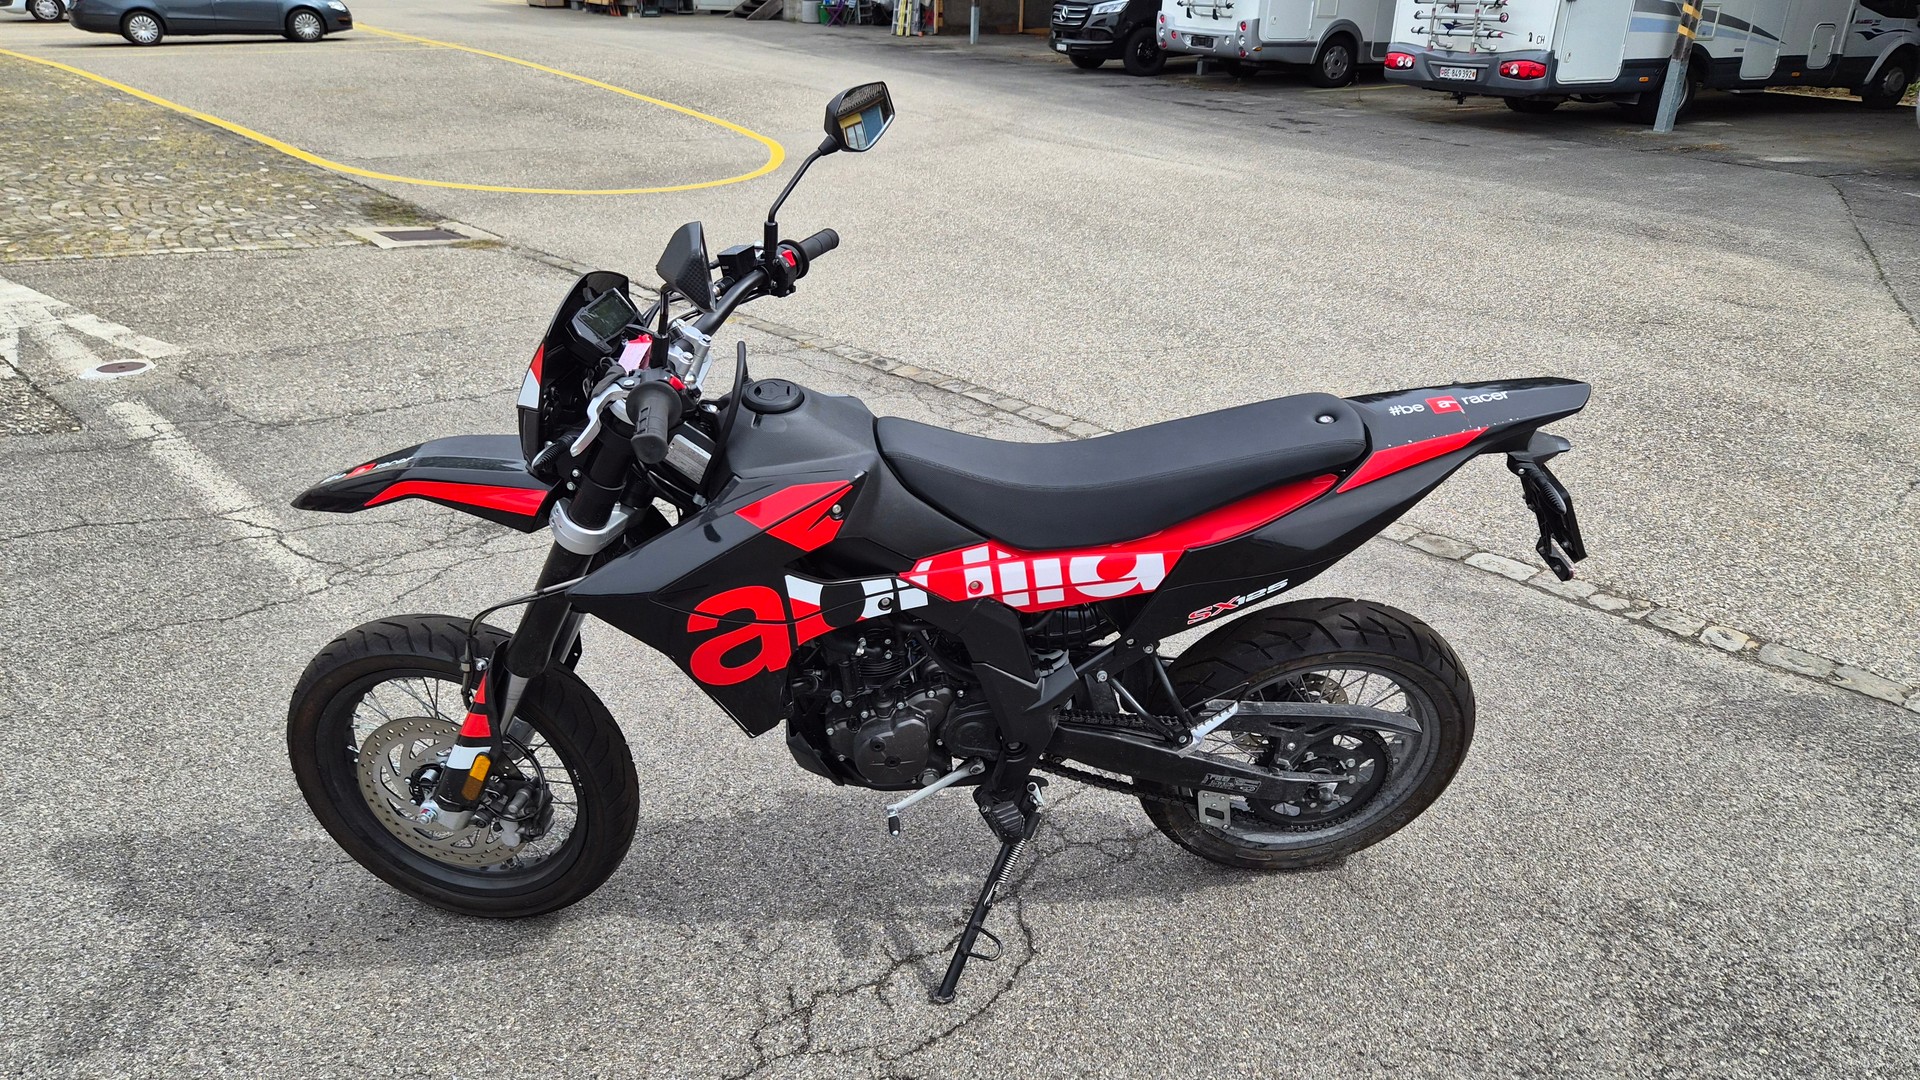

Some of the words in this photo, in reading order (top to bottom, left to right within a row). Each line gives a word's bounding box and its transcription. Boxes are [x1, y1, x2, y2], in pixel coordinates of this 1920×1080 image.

[1536, 35, 1545, 44] CH
[1444, 68, 1450, 77] BE
[1388, 403, 1425, 416] #be
[1461, 391, 1508, 405] racer
[1187, 578, 1289, 625] SX125
